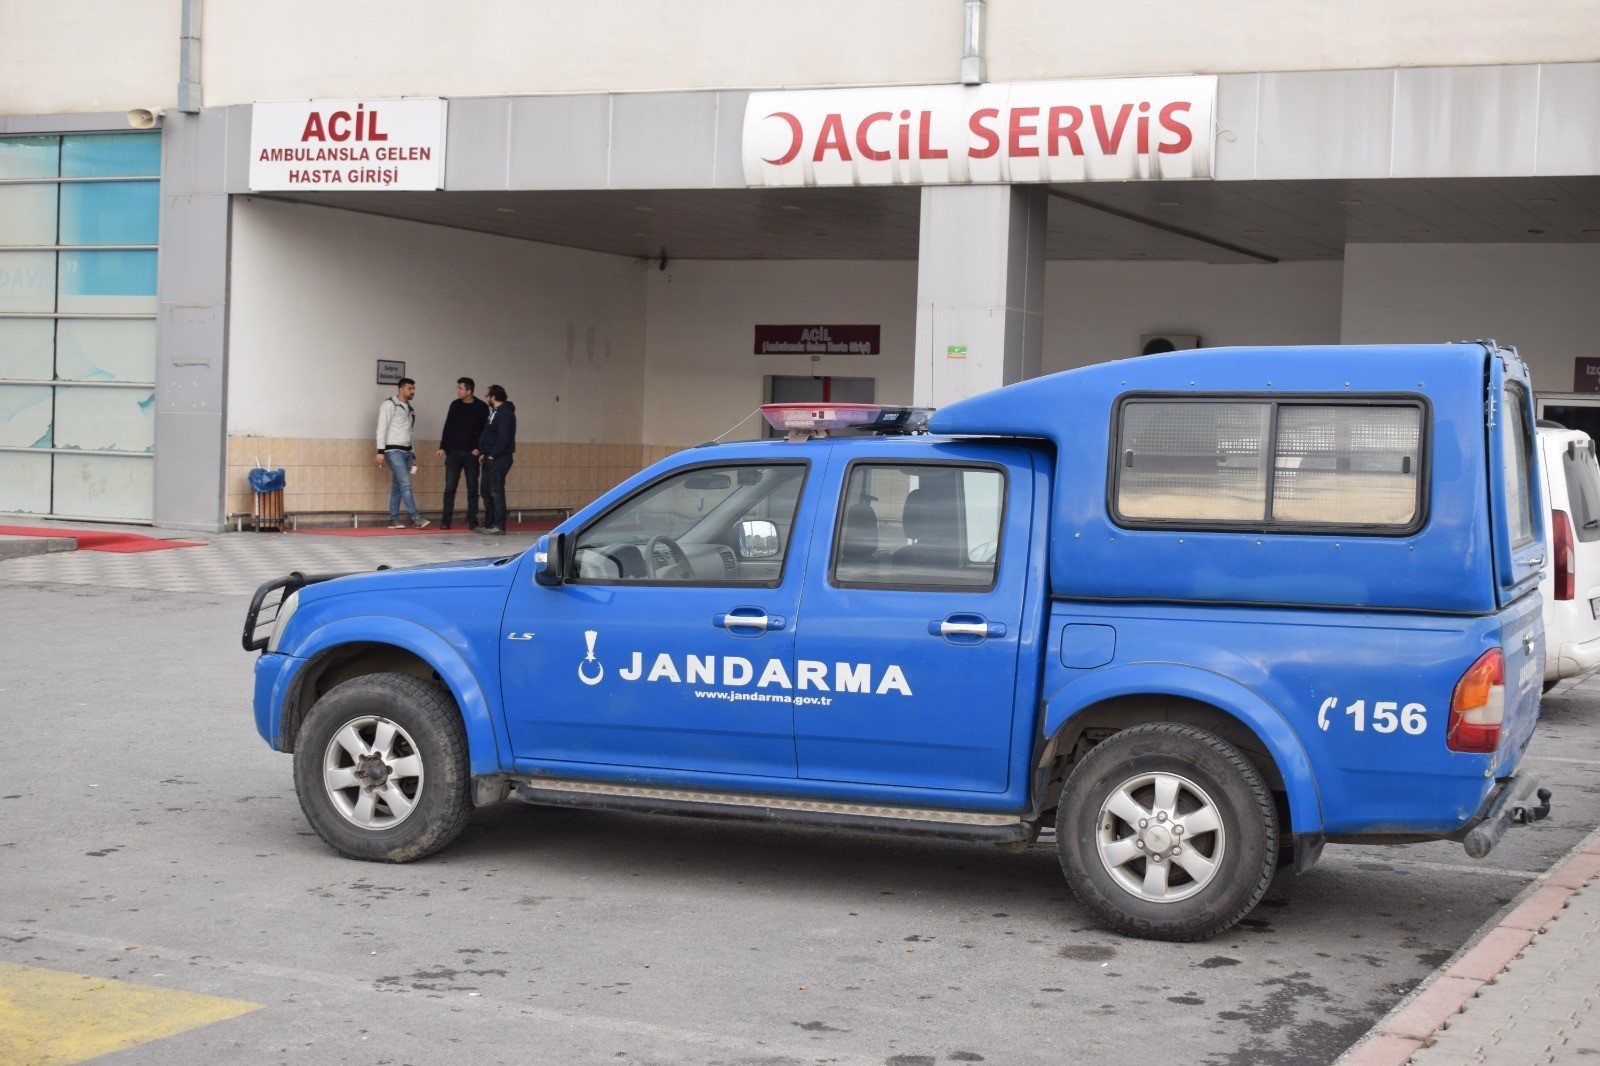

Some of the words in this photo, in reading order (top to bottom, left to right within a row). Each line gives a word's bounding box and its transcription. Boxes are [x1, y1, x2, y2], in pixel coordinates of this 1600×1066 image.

[301, 103, 388, 142] ACİL
[259, 147, 370, 162] AMBULANSLA
[375, 147, 432, 161] GELEN
[289, 169, 342, 183] HASTA
[348, 166, 398, 186] GİRİŞİ
[801, 326, 832, 342] ACİL
[507, 632, 535, 641] LS
[619, 652, 913, 696] JANDARMA
[694, 690, 832, 706] www.jandarma.gov.tr
[1345, 700, 1427, 735] 156
